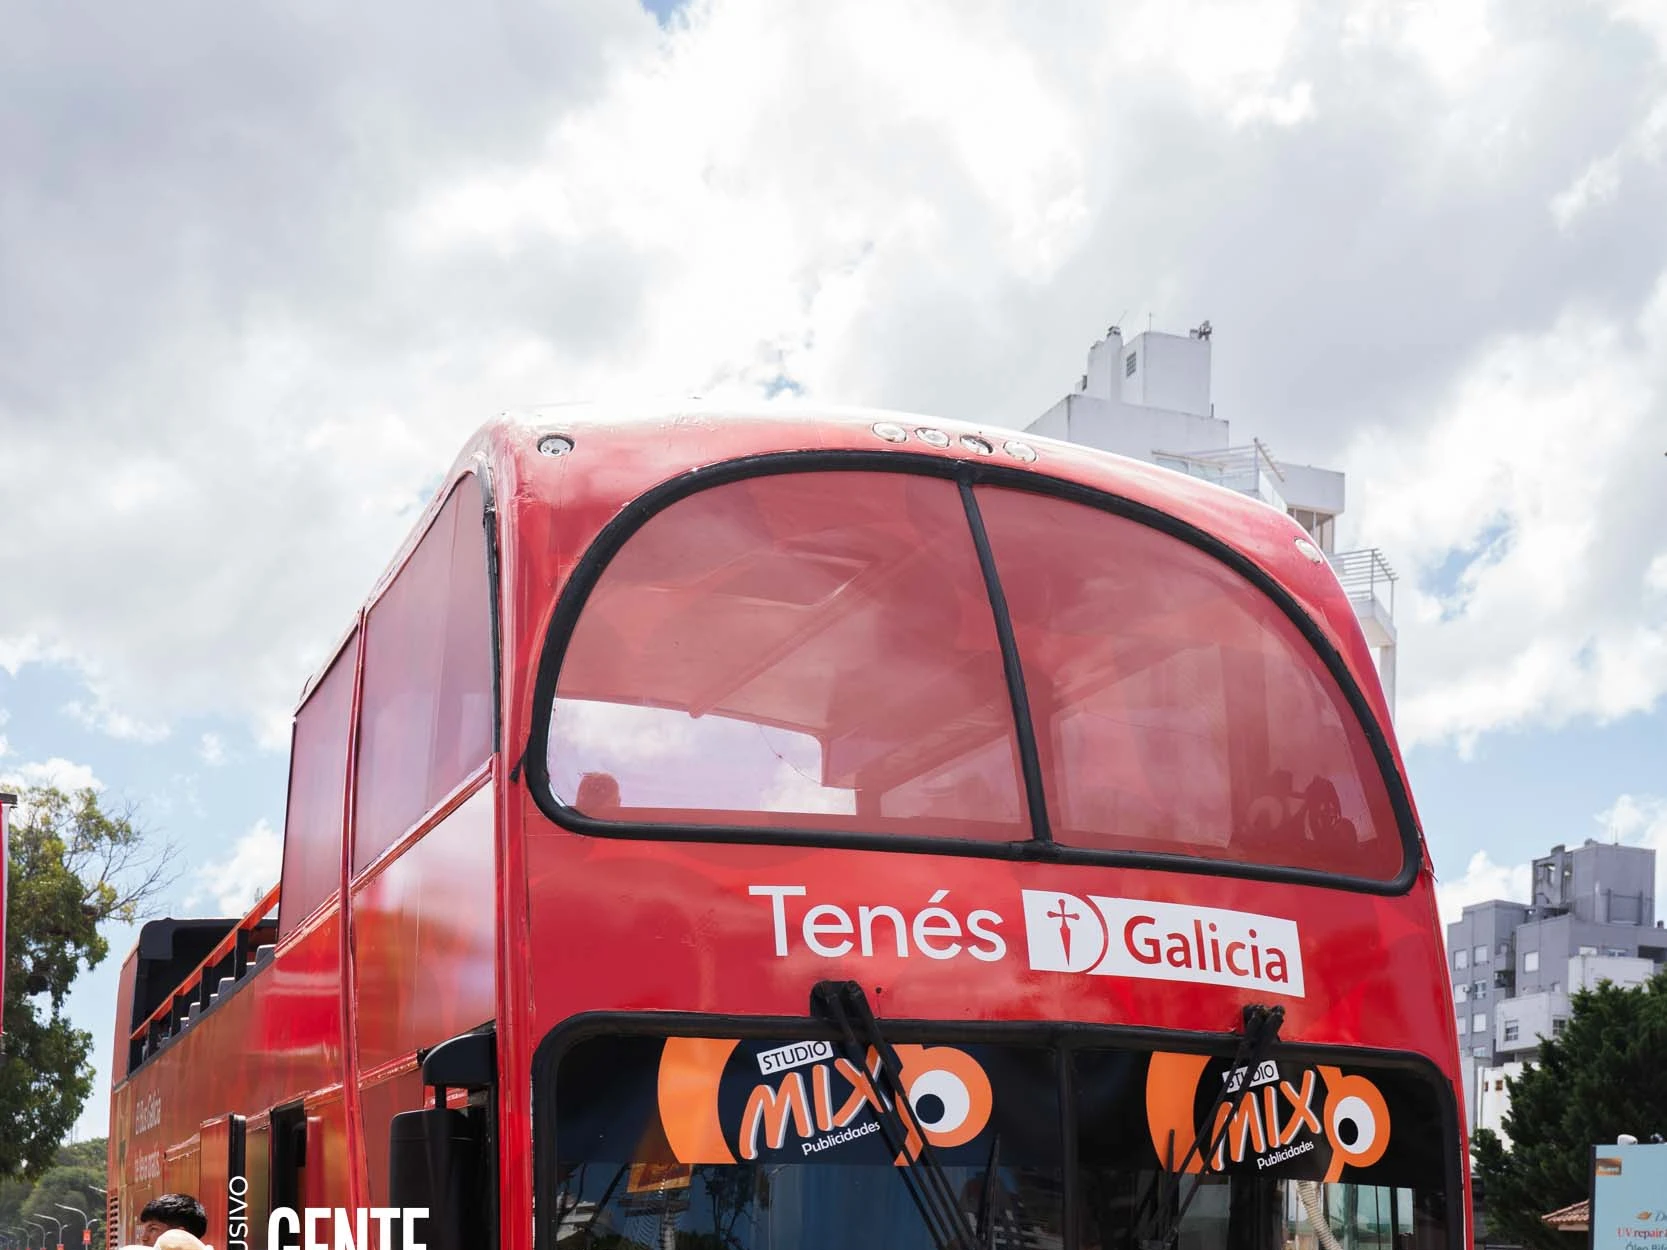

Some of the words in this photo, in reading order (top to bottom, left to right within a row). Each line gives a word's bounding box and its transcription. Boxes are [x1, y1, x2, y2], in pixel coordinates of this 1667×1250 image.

[748, 885, 1007, 963] Tenés
[1123, 914, 1290, 985] Galicia
[762, 1042, 828, 1071] STUDIO
[738, 1044, 894, 1160] MIX
[1211, 1069, 1322, 1171] MIX
[801, 1121, 881, 1156] Publicidades
[1256, 1140, 1315, 1170] Publicidades
[1633, 1228, 1664, 1240] repair
